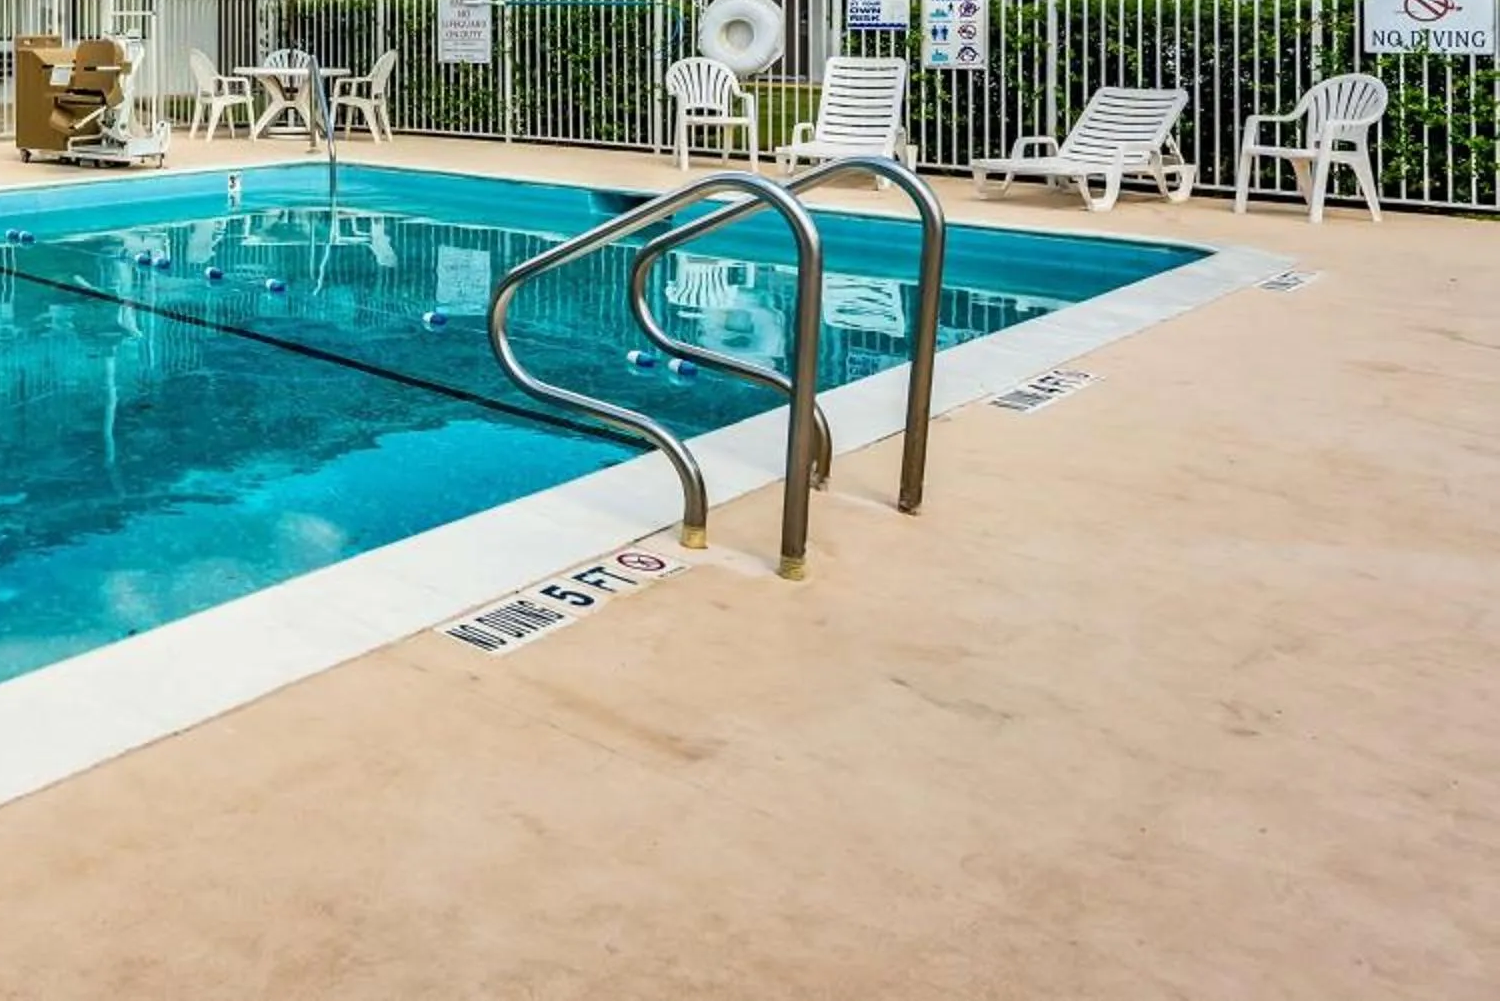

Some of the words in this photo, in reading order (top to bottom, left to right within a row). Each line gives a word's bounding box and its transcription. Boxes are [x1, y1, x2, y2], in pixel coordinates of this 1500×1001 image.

[850, 14, 881, 22] RISK
[1372, 29, 1402, 48] NO
[571, 565, 639, 594] FT
[540, 584, 595, 607] 5
[474, 599, 565, 638] DIVING
[444, 624, 507, 652] NO
